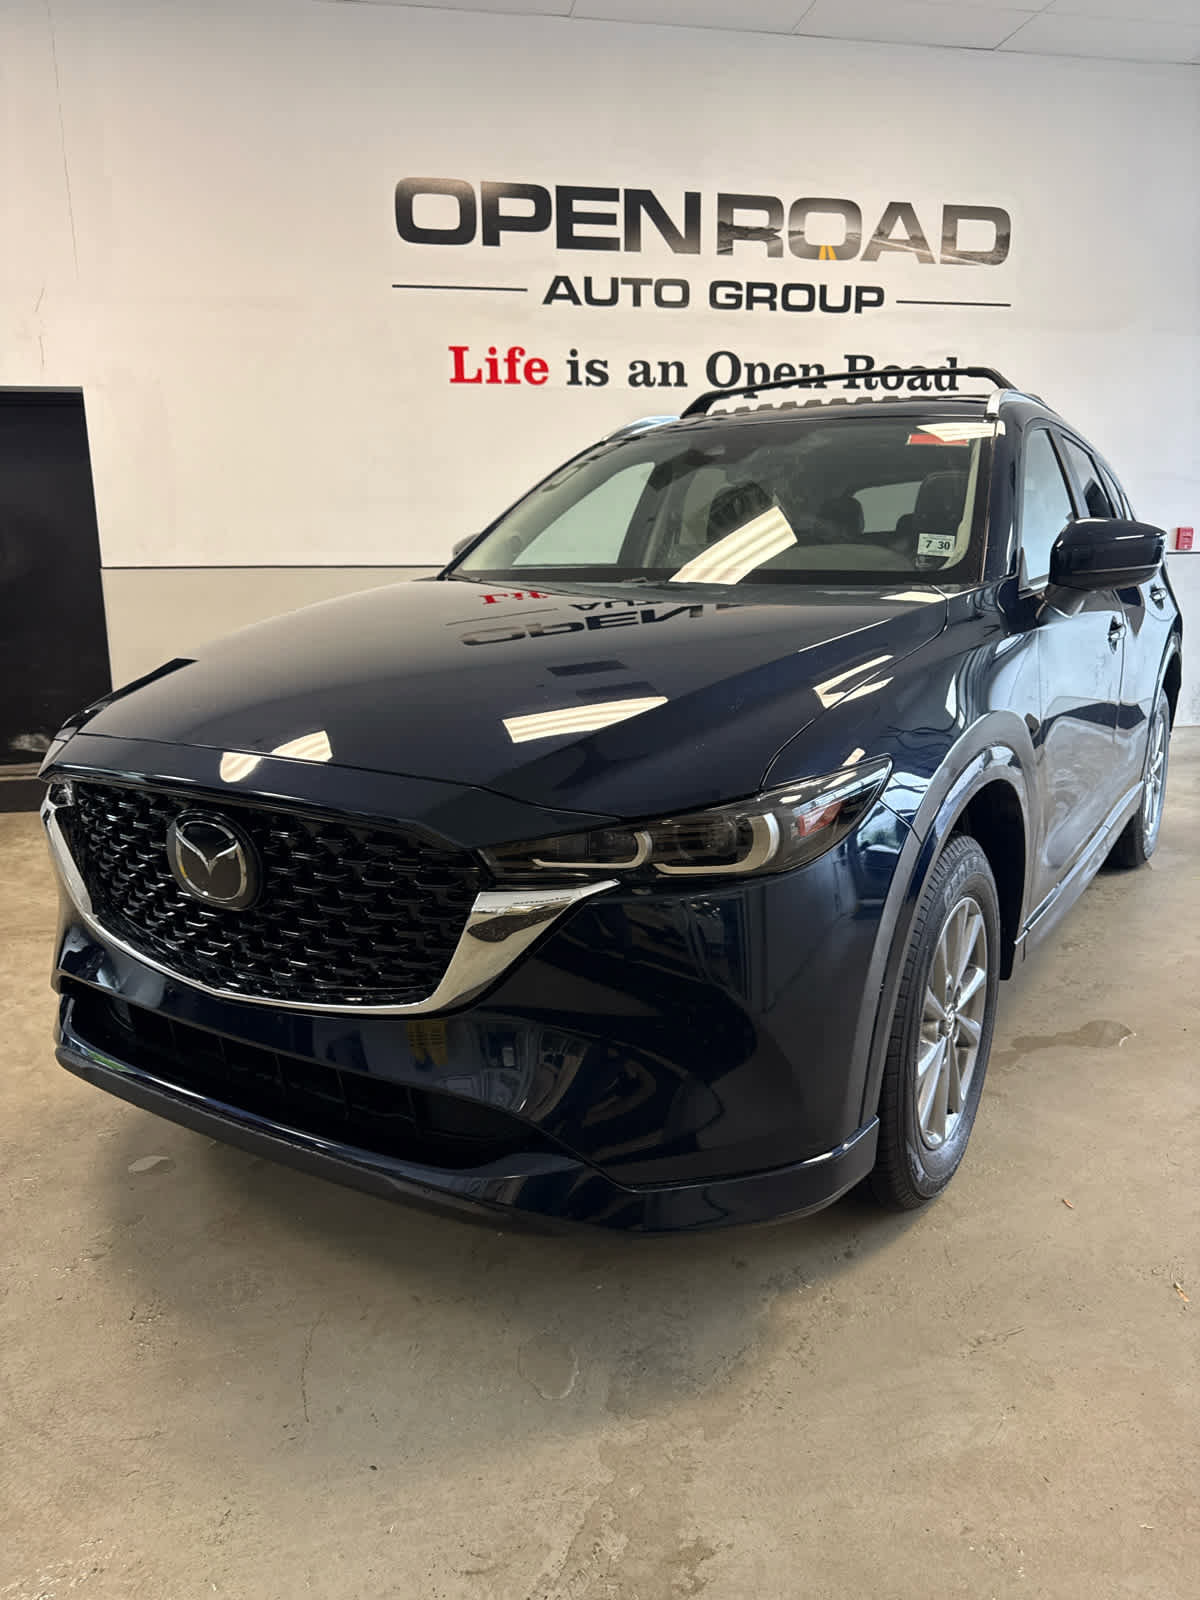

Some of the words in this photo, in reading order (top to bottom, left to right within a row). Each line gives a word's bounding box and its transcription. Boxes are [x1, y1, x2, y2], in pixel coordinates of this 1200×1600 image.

[394, 176, 702, 256] OPEN
[716, 191, 1012, 266] ROAD
[541, 274, 691, 309] AUTO
[708, 279, 885, 315] GROUP
[447, 345, 550, 387] Life
[565, 347, 610, 388] is
[627, 359, 689, 388] an
[925, 540, 933, 549] 7
[937, 541, 951, 550] 30
